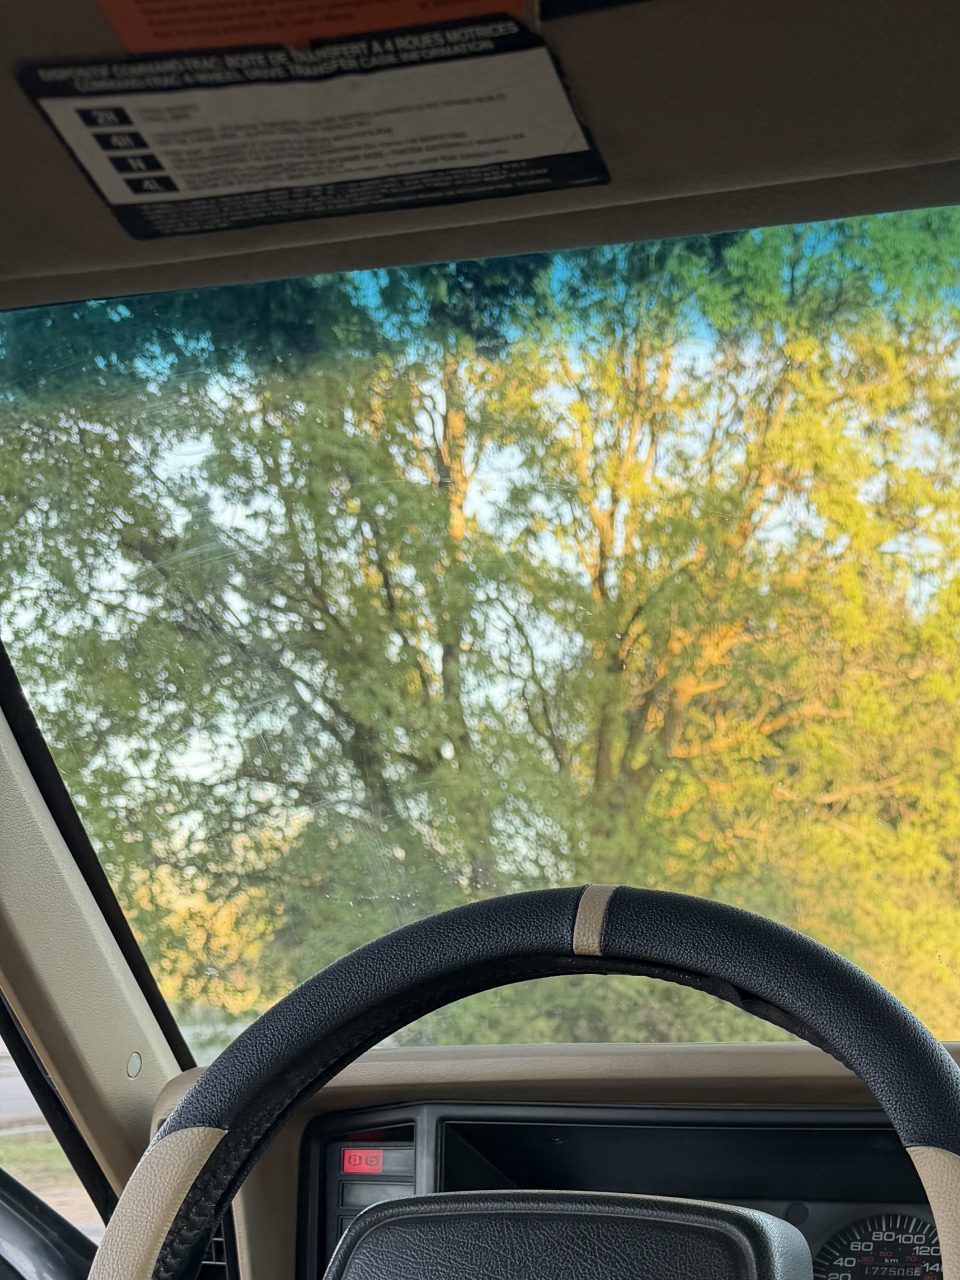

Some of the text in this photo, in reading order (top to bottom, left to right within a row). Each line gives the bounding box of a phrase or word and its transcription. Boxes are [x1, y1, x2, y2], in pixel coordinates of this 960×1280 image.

[871, 1231, 895, 1242] 80
[895, 1234, 926, 1245] 100
[850, 1241, 874, 1252] 60
[912, 1246, 941, 1257] 120
[833, 1257, 856, 1268] 40
[922, 1262, 943, 1274] 14
